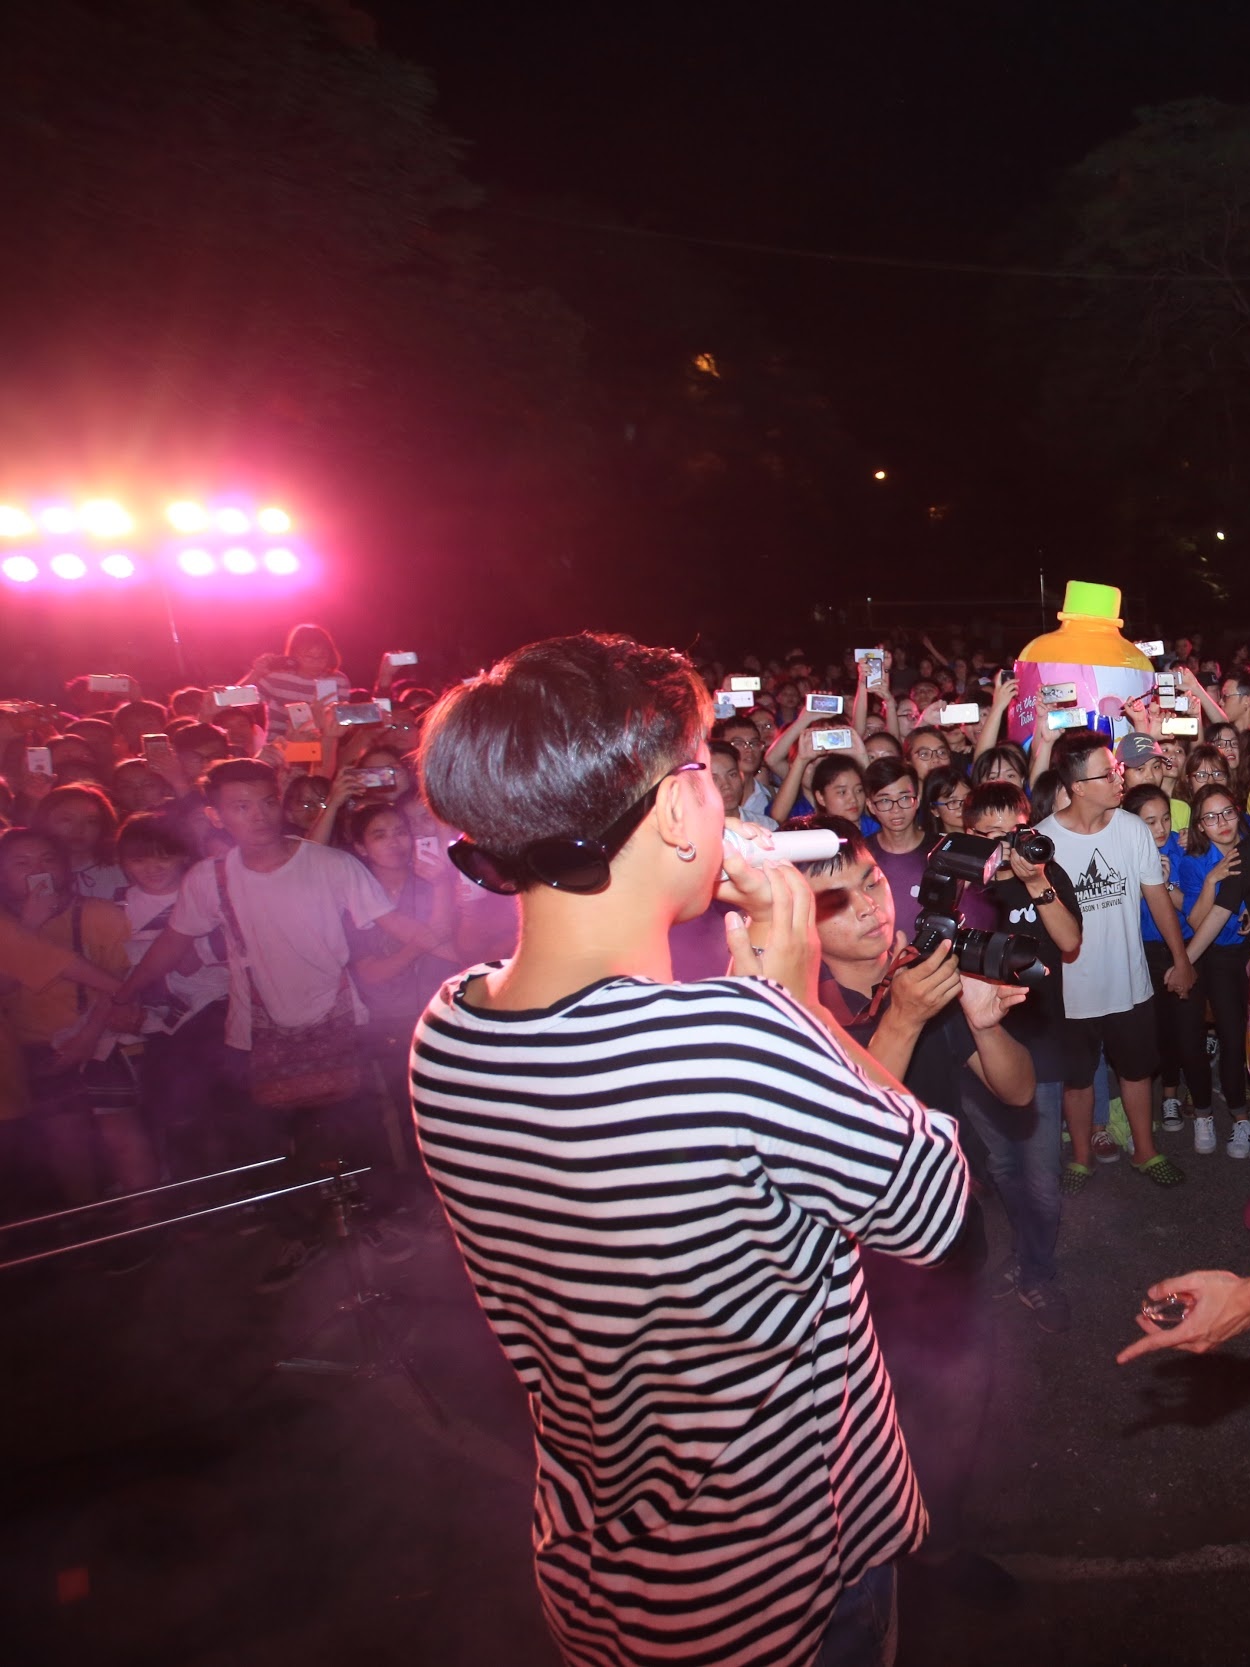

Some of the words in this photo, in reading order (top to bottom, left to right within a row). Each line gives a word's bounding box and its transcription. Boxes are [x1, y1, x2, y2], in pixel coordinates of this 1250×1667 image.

[1023, 696, 1038, 709] thậ
[1074, 880, 1125, 902] HALLENGE
[1102, 898, 1122, 909] SURVIVAL
